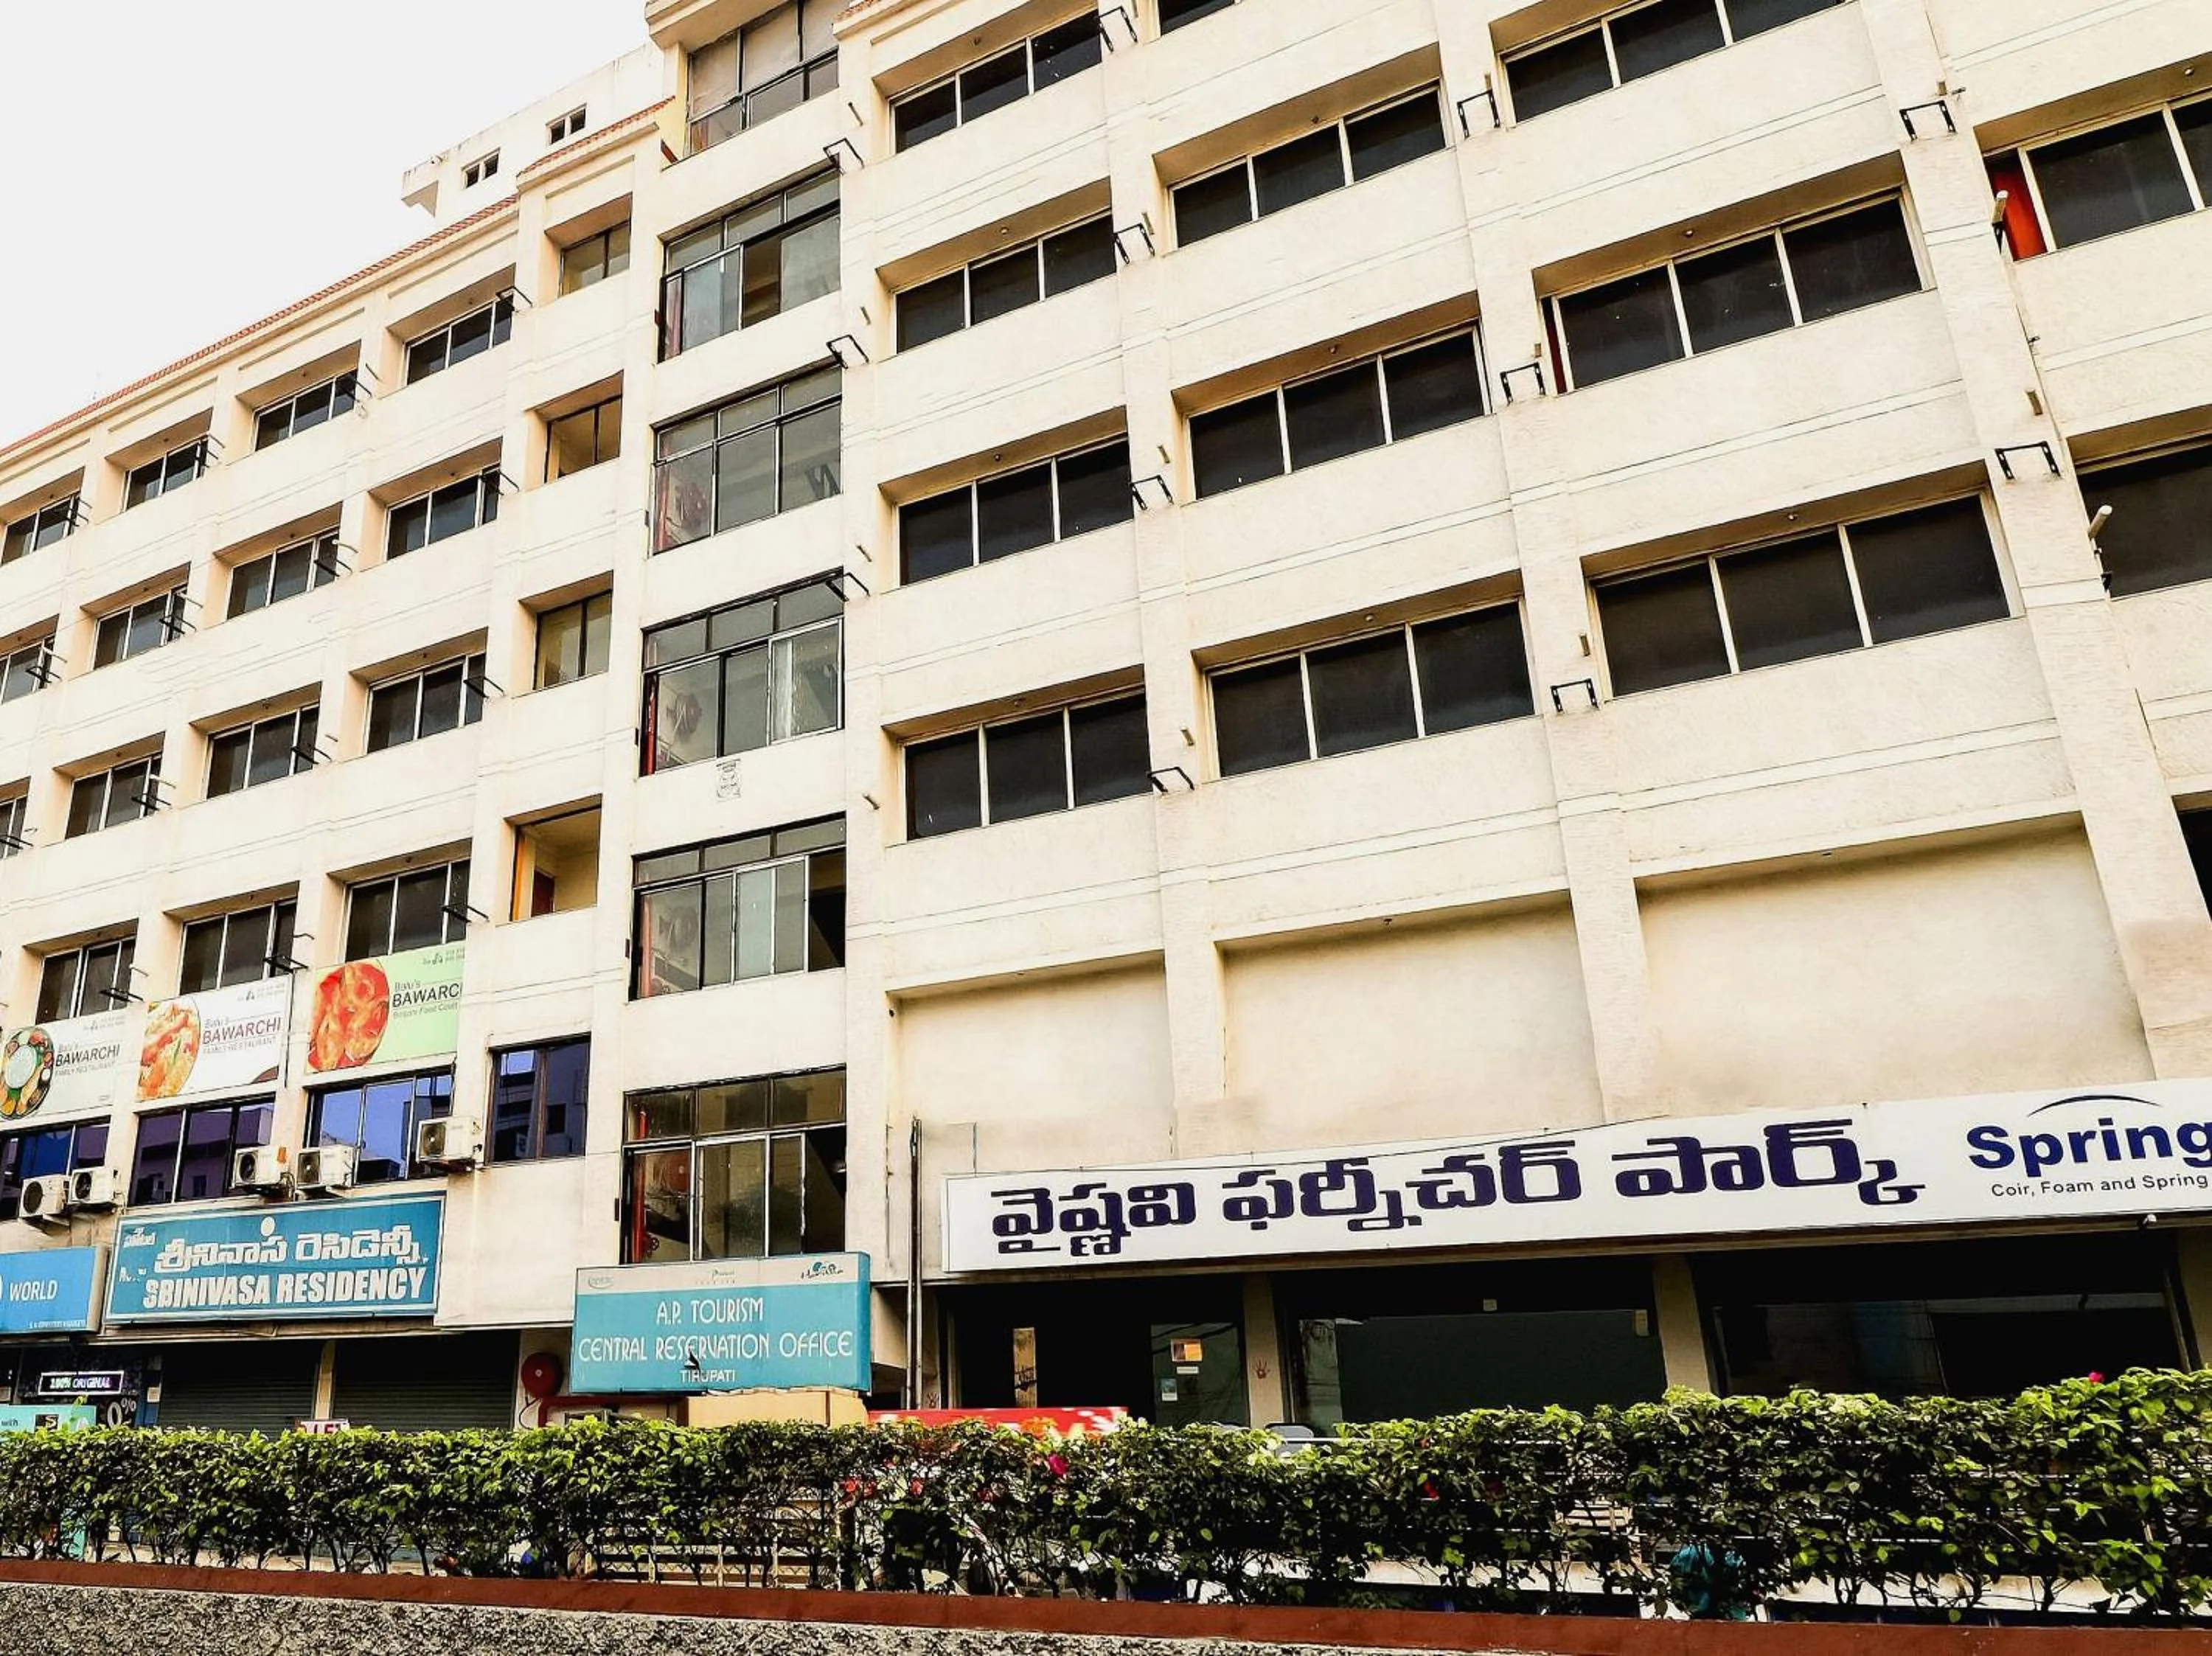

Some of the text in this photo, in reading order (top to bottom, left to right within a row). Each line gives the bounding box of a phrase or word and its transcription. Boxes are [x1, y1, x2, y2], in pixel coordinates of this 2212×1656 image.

[203, 1017, 281, 1045] BAWARCHI
[56, 1044, 120, 1067] BAWARCHI
[991, 1182, 1197, 1256] వైష్ణవి
[1611, 1119, 1926, 1206] పార్క్
[1991, 1173, 2208, 1197] Coir, Foam and Spring
[10, 1279, 58, 1301] WORLD
[142, 1274, 271, 1309] SRINIVASA
[276, 1267, 427, 1304] RESIDENCY
[656, 1296, 764, 1325] A.P. TOURISM
[578, 1330, 853, 1363] CENTRAL RESERVATION OFFICE
[72, 1376, 111, 1389] ORIGINAL
[680, 1368, 735, 1384] TIRUPATI
